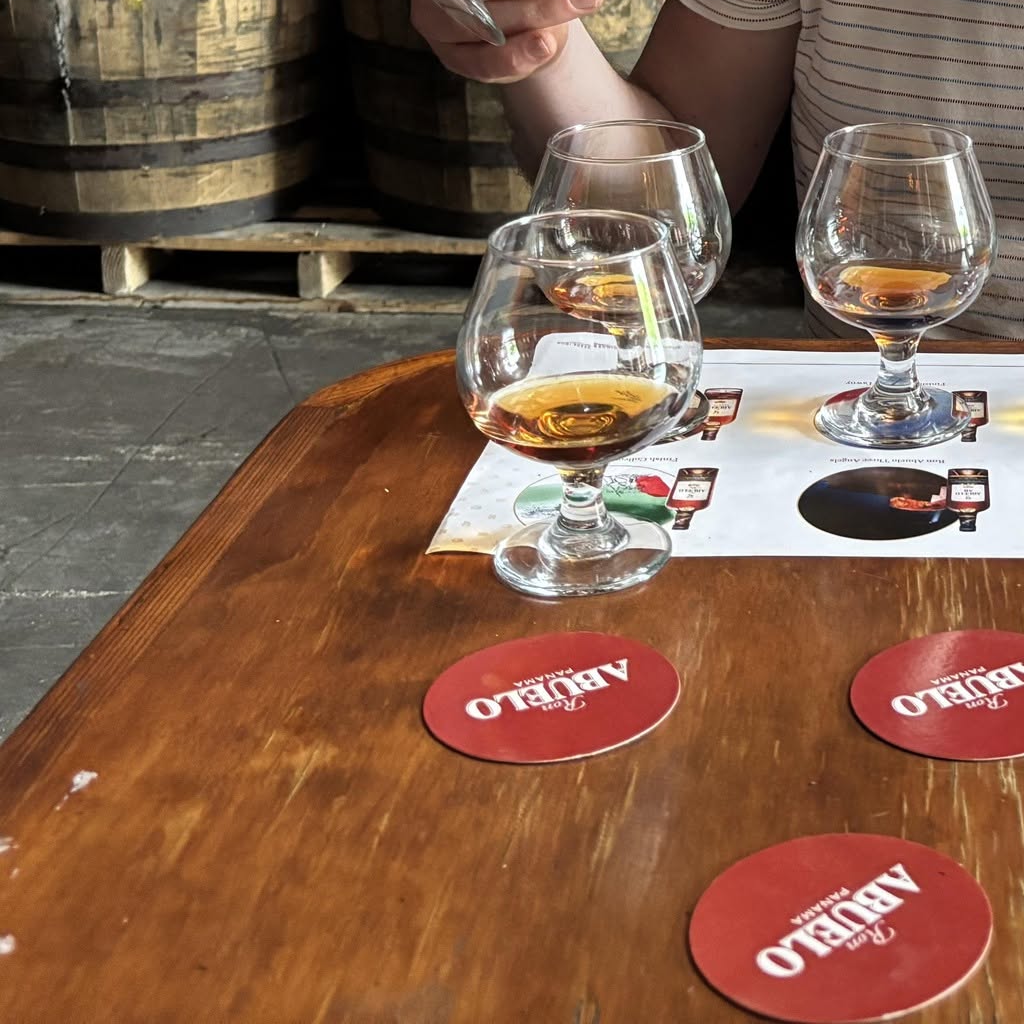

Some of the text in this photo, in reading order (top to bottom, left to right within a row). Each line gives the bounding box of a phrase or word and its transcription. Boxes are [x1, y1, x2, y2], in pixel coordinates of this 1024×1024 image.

[513, 667, 574, 688] PANAMA
[929, 666, 987, 684] PANAMA
[465, 658, 629, 720] ABUELO
[966, 692, 1009, 709] Ron
[542, 694, 587, 712] Ron
[789, 887, 851, 926] PANAMA
[756, 862, 921, 978] ABUELO
[845, 919, 896, 951] Ron
